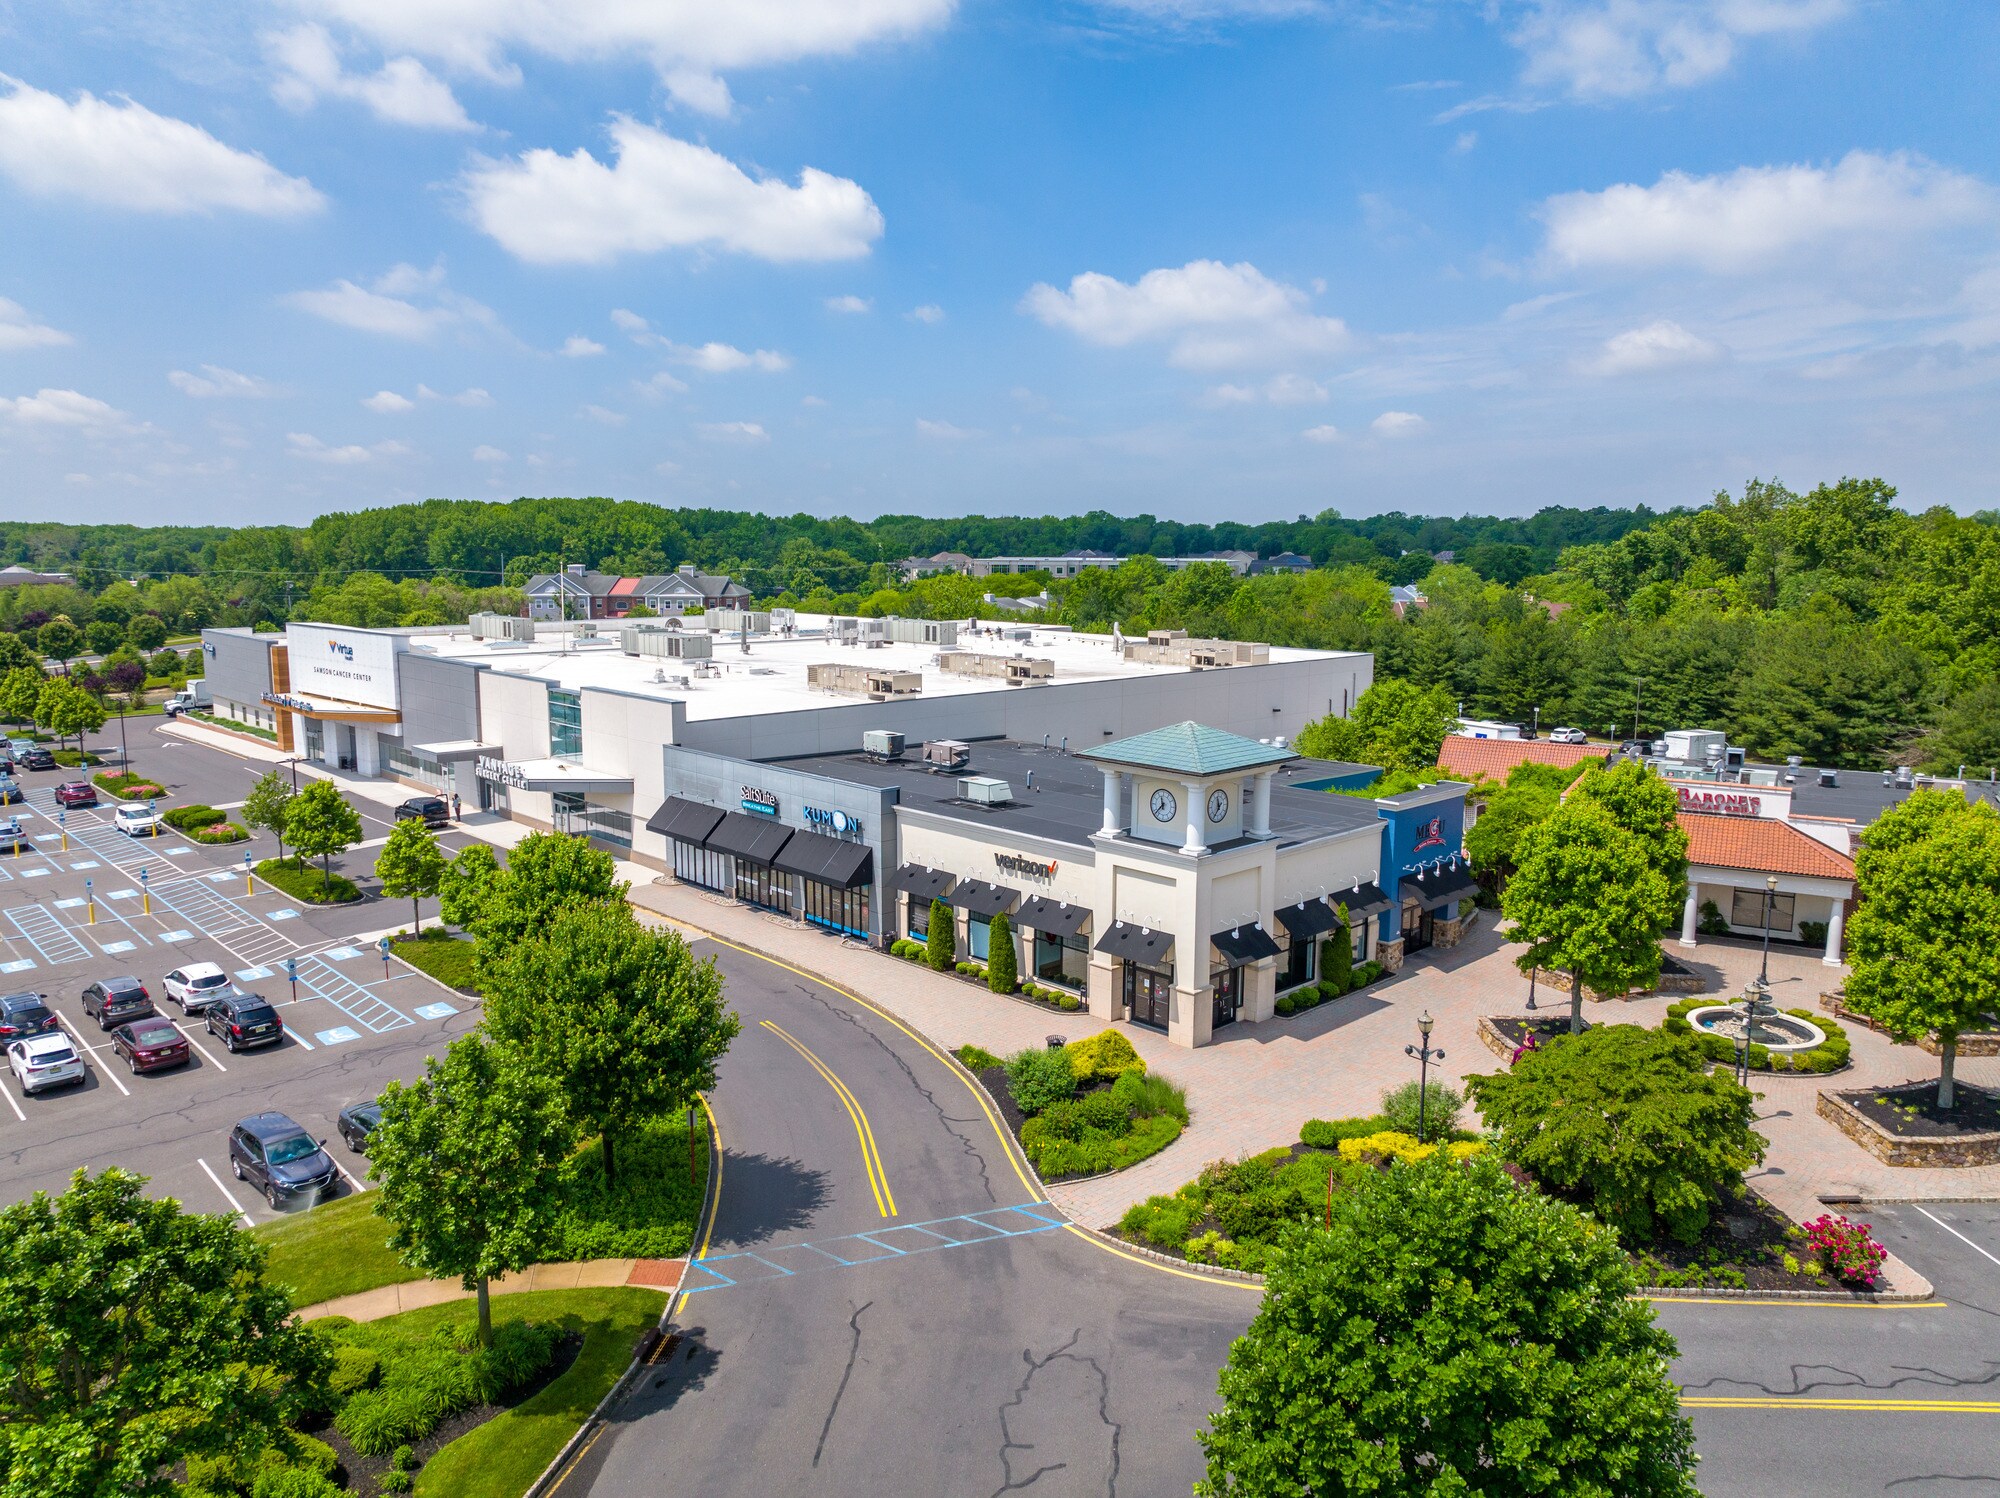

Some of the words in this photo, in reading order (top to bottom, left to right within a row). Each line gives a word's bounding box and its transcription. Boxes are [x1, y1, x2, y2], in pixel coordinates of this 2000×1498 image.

[336, 643, 354, 656] Virtua
[313, 666, 332, 676] SAMSON
[332, 669, 352, 679] CANCER
[353, 673, 372, 682] CENTER
[501, 773, 528, 790] CENTER
[803, 805, 859, 832] KUMON
[994, 852, 1050, 878] verizon
